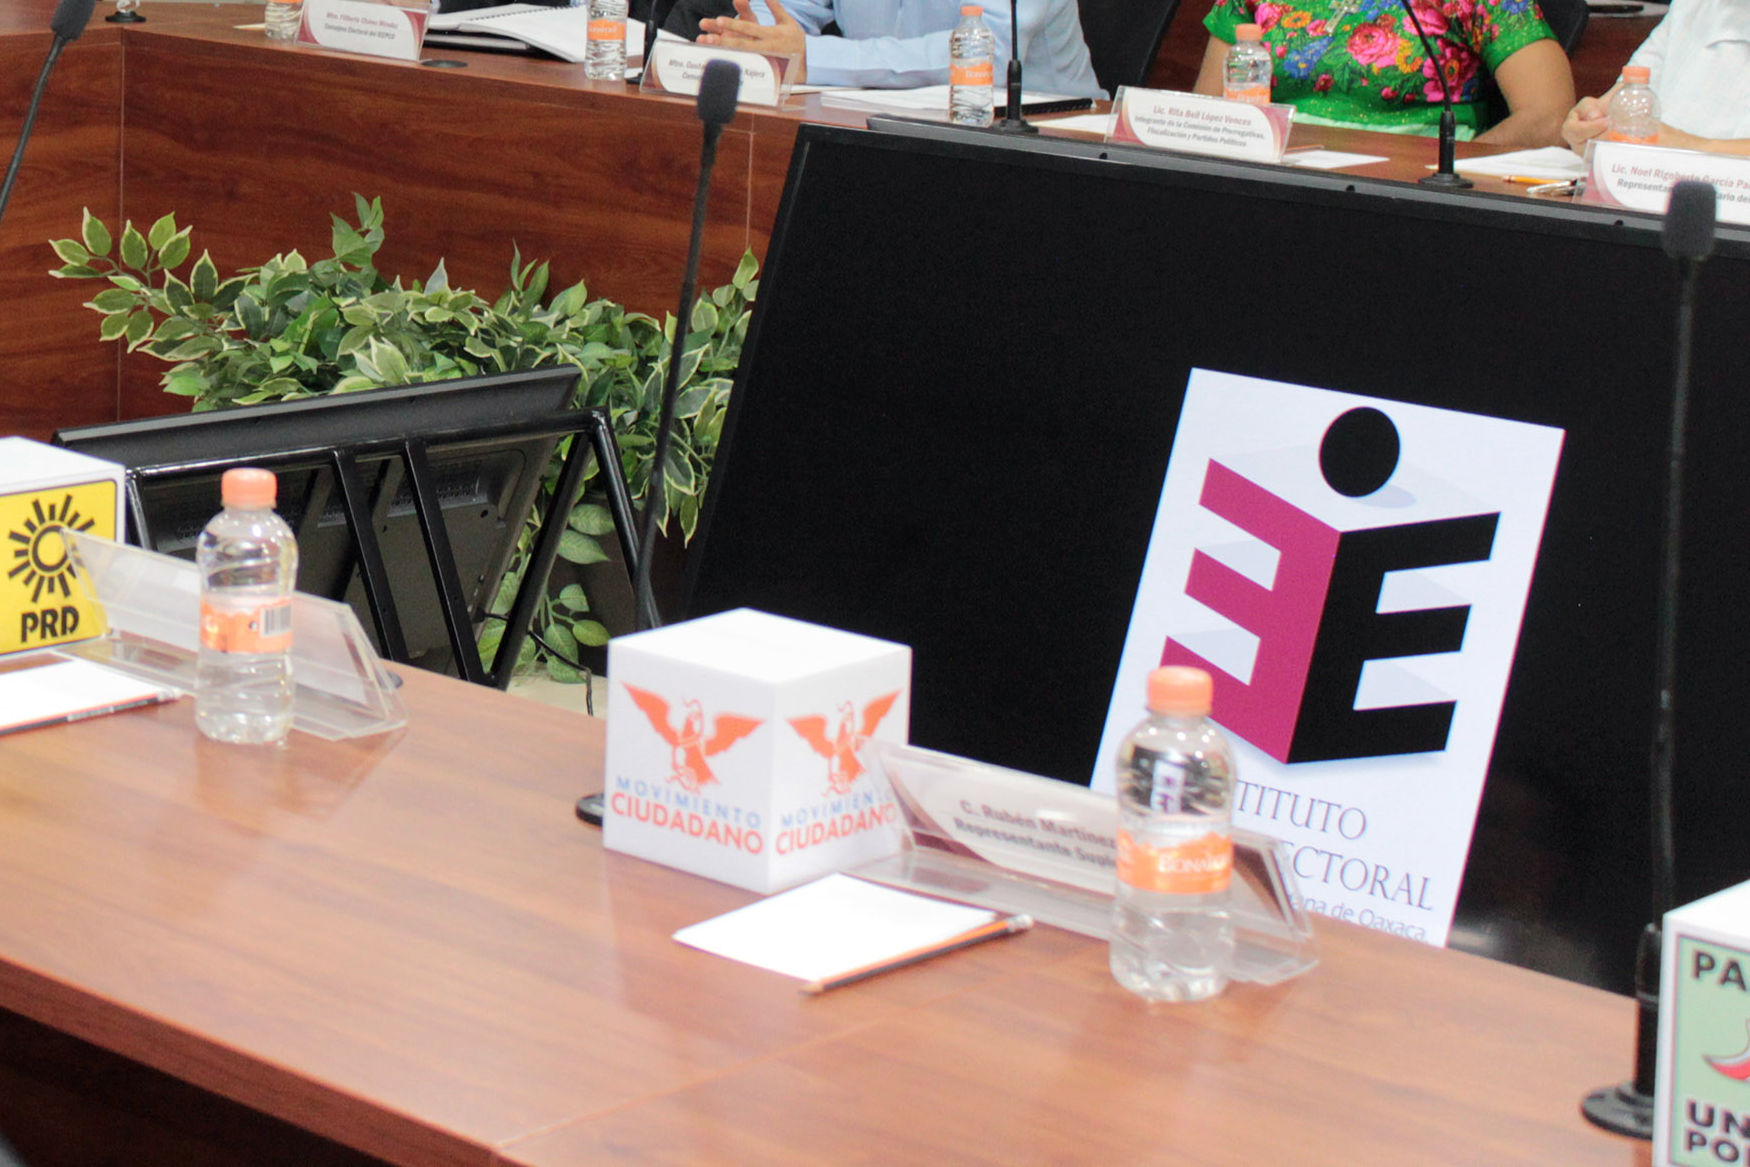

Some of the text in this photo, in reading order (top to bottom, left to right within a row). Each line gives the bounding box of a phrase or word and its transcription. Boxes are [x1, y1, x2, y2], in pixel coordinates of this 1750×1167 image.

[1153, 106, 1165, 115] Lic.
[1168, 107, 1183, 118] Rita
[1201, 110, 1223, 123] López
[1611, 164, 1628, 175] Lic.
[1630, 166, 1652, 176] Noel
[21, 605, 79, 643] PRD
[611, 791, 764, 854] CIUDADANO
[615, 775, 761, 829] MOVIMIENTO
[1237, 779, 1367, 840] TITUTO
[775, 802, 898, 856] CIUDADANO
[953, 817, 1072, 857] Representante
